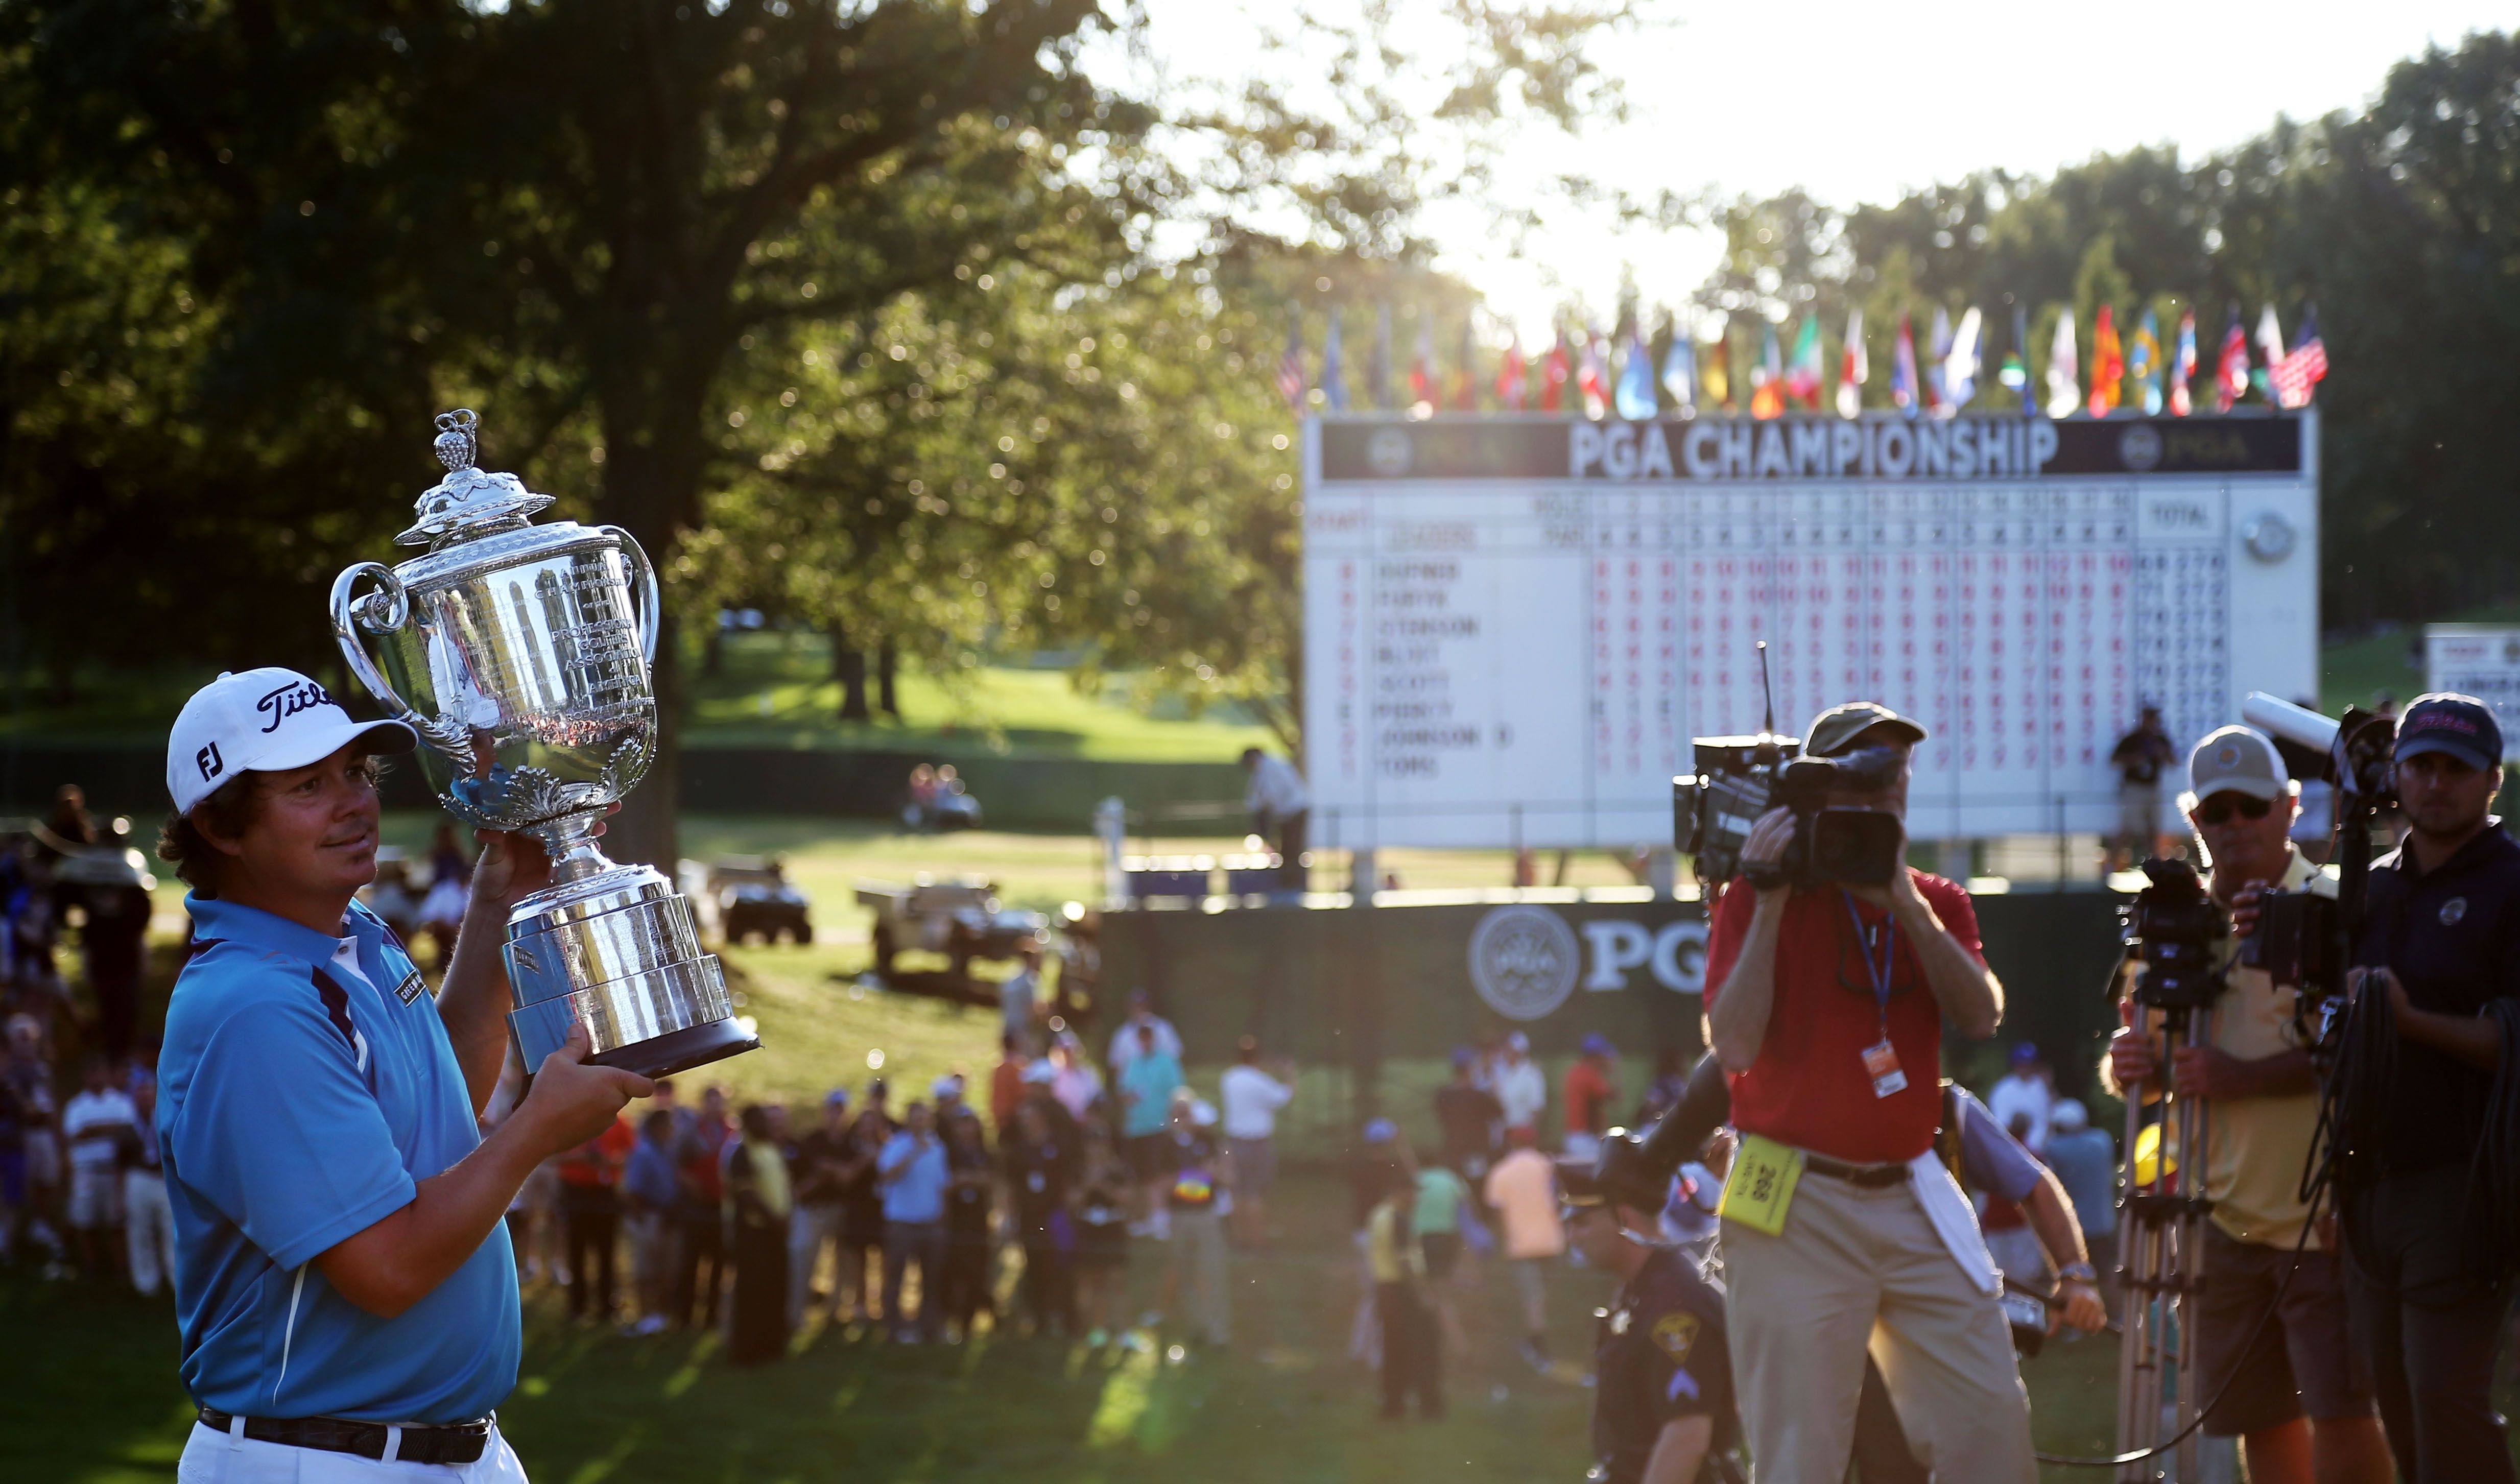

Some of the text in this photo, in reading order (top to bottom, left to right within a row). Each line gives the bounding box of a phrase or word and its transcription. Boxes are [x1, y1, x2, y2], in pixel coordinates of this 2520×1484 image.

[1567, 422, 1675, 479] PGA
[1681, 419, 2058, 479] CHAMPIONSHIP
[2148, 501, 2210, 526] TOTAL
[1375, 559, 1461, 584] DUFNER
[1375, 615, 1479, 639] STENSON
[1375, 671, 1451, 695] SCOTT
[1375, 724, 1480, 748] JOHNSON
[196, 741, 224, 783] FJ
[1375, 753, 1438, 778] TOMS
[1584, 920, 1708, 994] PG
